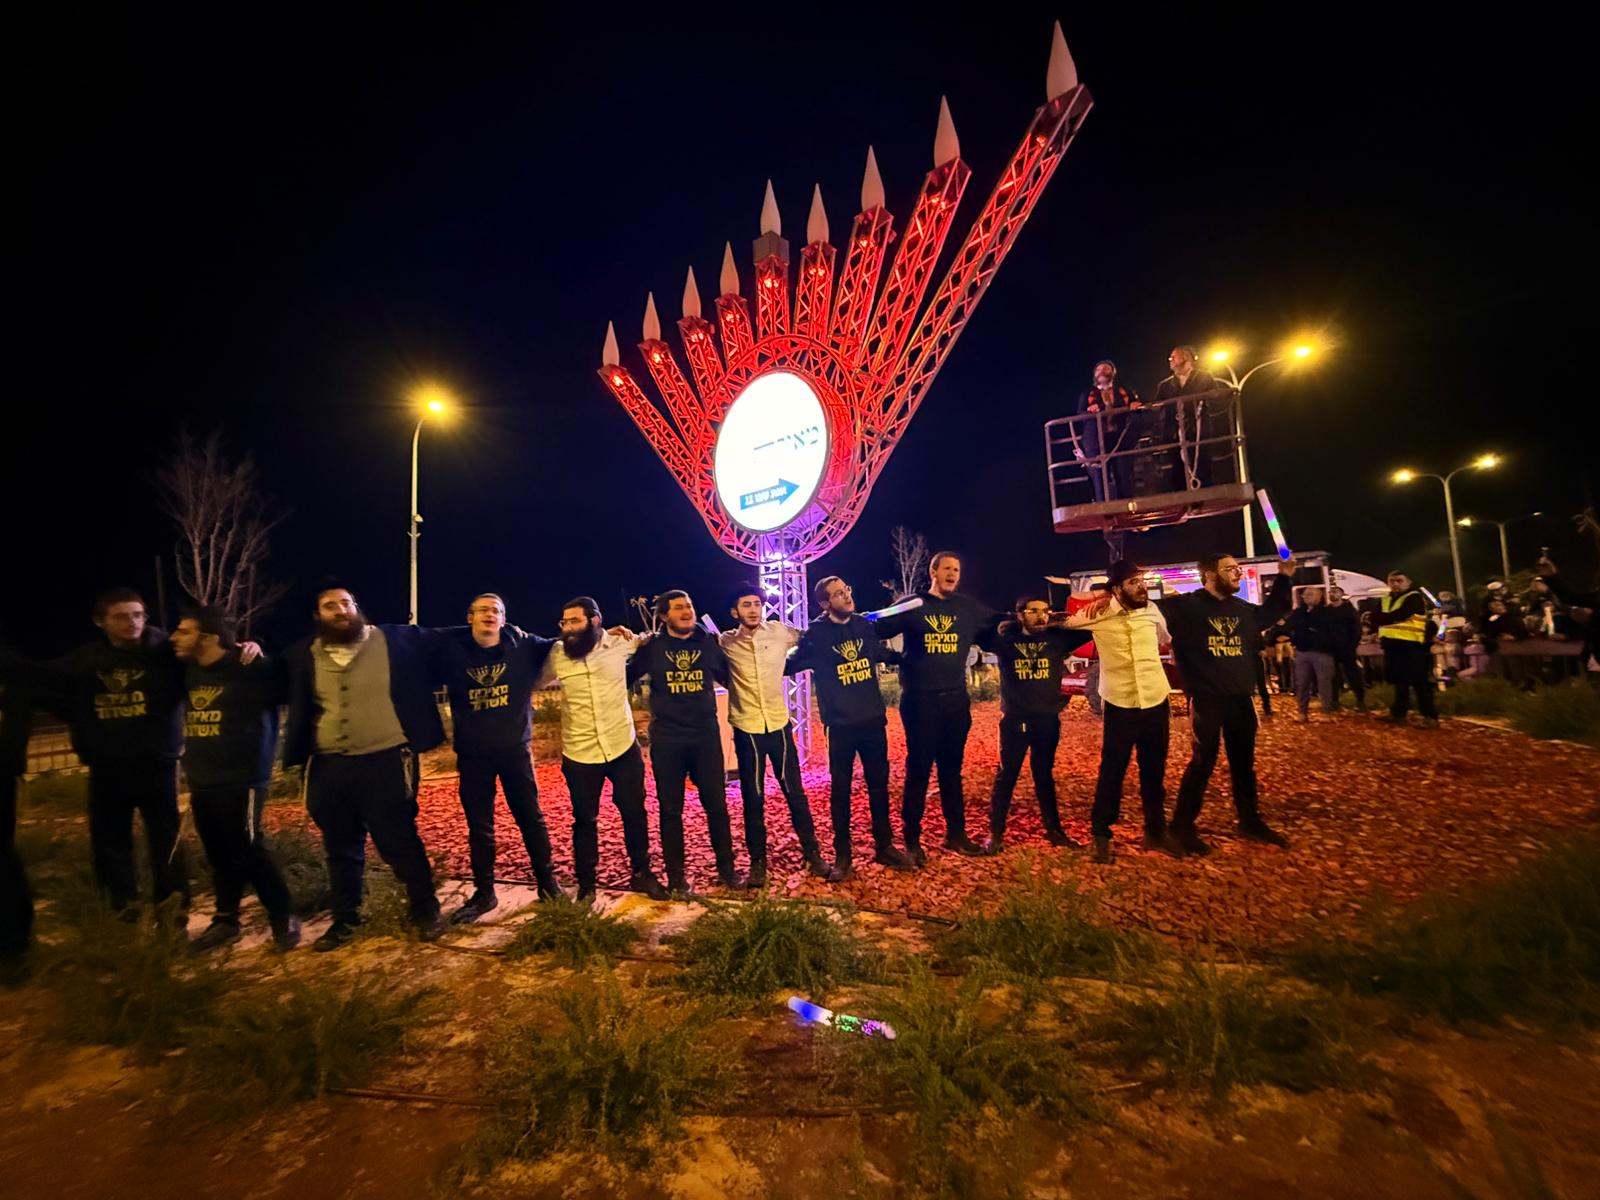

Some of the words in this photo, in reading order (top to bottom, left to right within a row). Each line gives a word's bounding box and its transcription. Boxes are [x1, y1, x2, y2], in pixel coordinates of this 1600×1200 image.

[924, 643, 958, 653] אשדוד
[837, 658, 870, 675] מאירים
[838, 668, 872, 686] אשדוד
[666, 681, 704, 694] אשדוד
